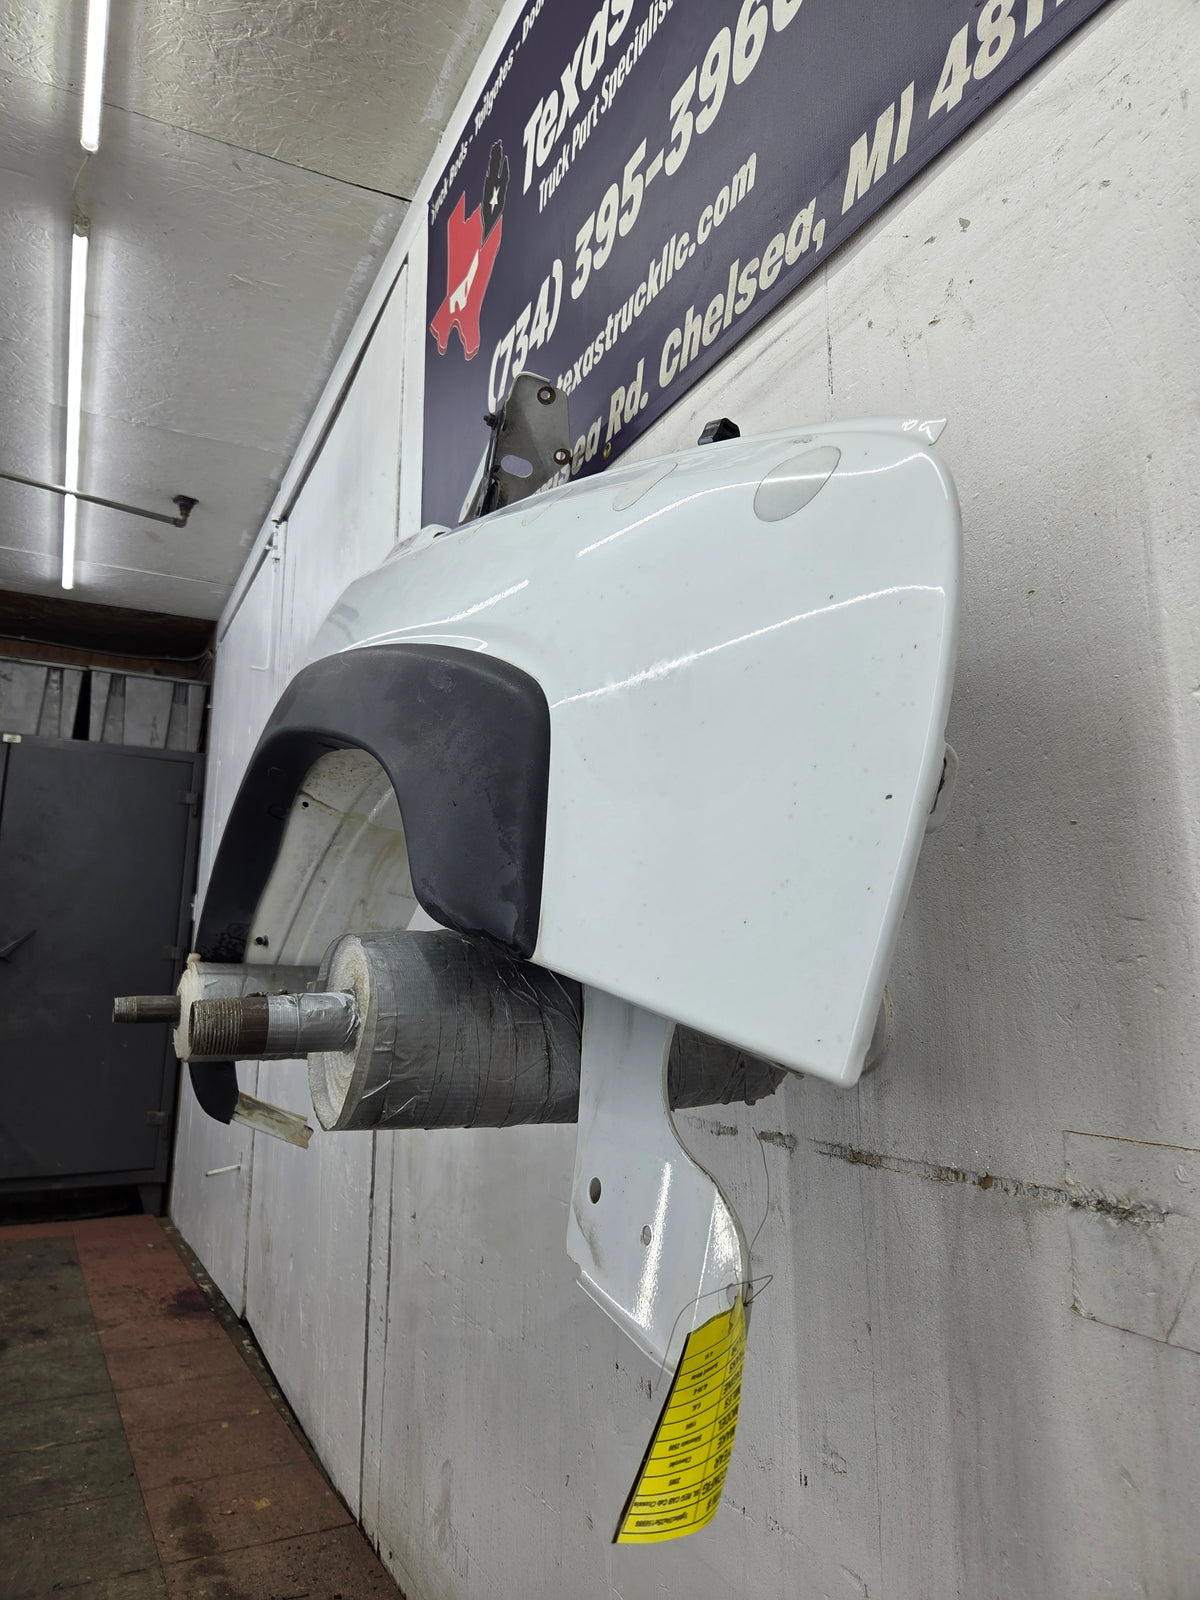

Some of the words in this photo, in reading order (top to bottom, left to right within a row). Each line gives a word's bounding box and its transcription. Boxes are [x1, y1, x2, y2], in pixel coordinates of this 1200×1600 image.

[474, 49, 514, 136] Tailgates
[523, 0, 635, 196] Texas
[539, 143, 570, 213] Truck
[571, 94, 599, 163] Part
[488, 258, 563, 413] (734)
[556, 152, 757, 396] texastruckllc.com
[605, 357, 649, 443] Rd.
[658, 197, 826, 388] Chelsea,
[841, 80, 915, 215] MI
